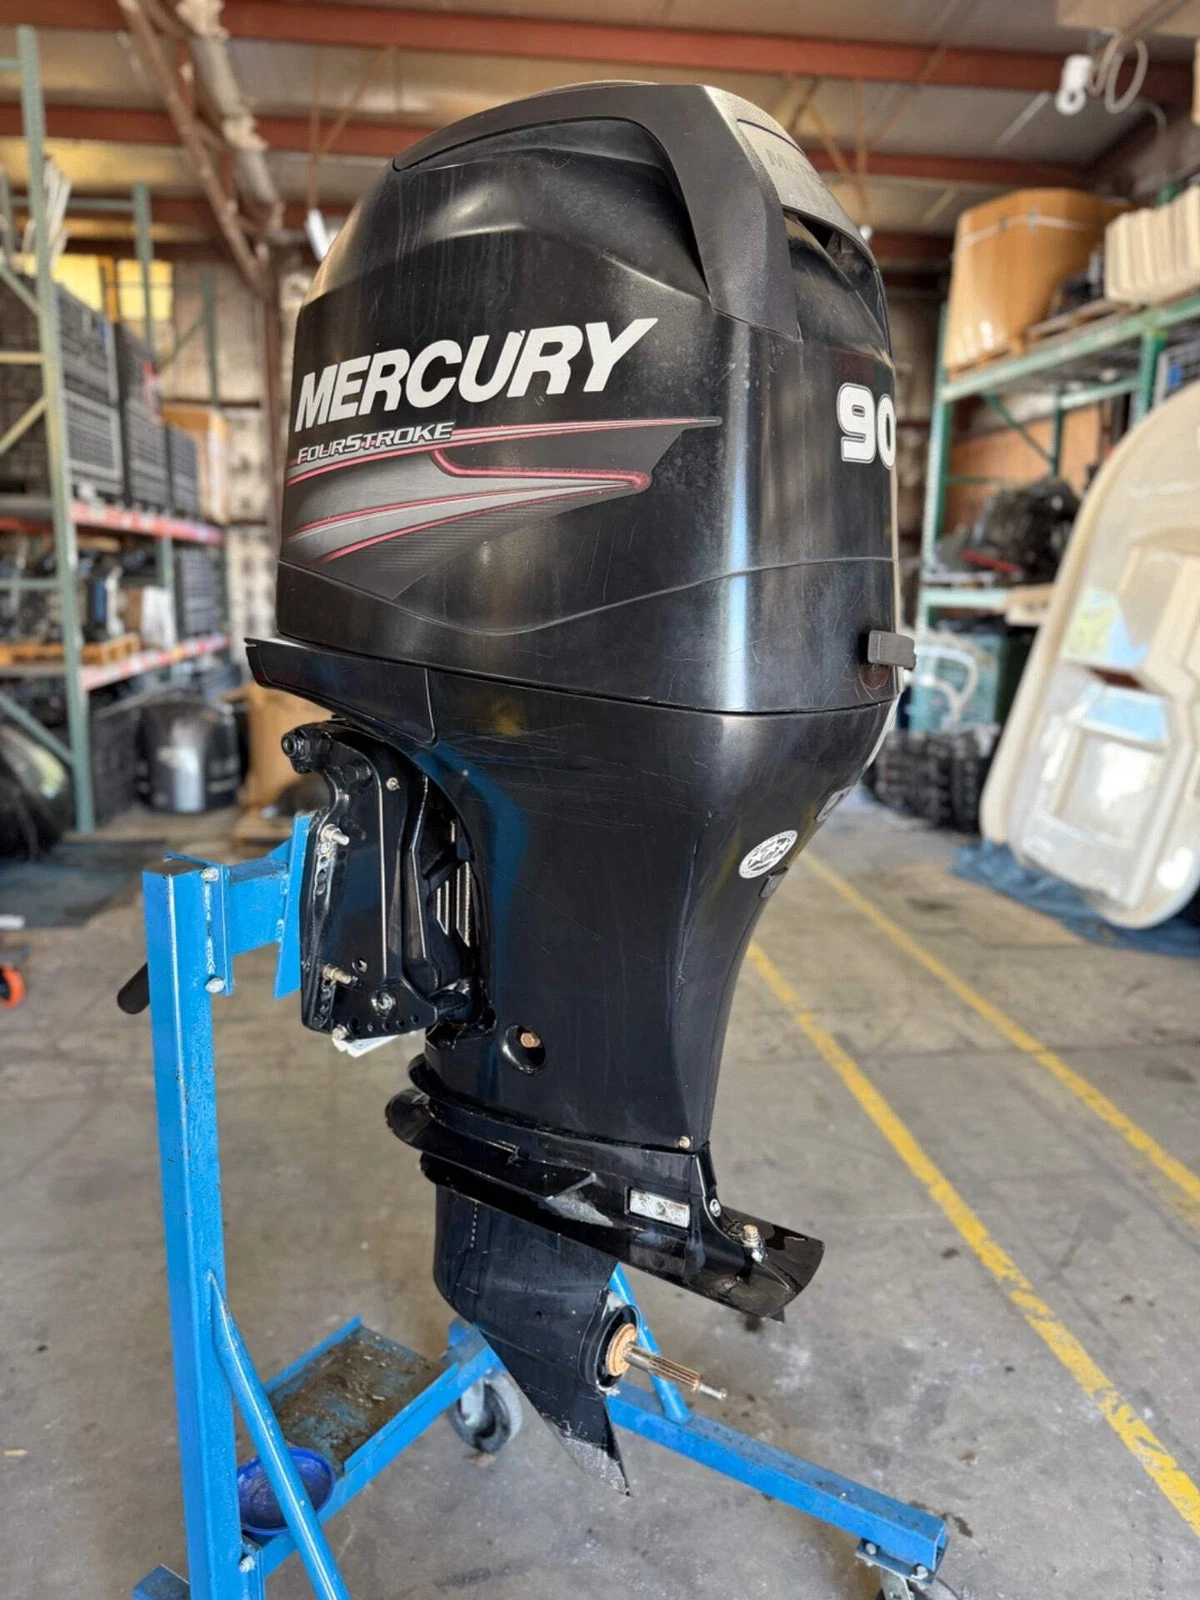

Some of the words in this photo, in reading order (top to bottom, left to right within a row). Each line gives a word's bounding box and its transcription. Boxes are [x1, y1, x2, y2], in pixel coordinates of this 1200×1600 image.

[294, 317, 658, 432] MERCURY
[296, 421, 455, 464] FOURSTROKE
[836, 382, 897, 470] 90
